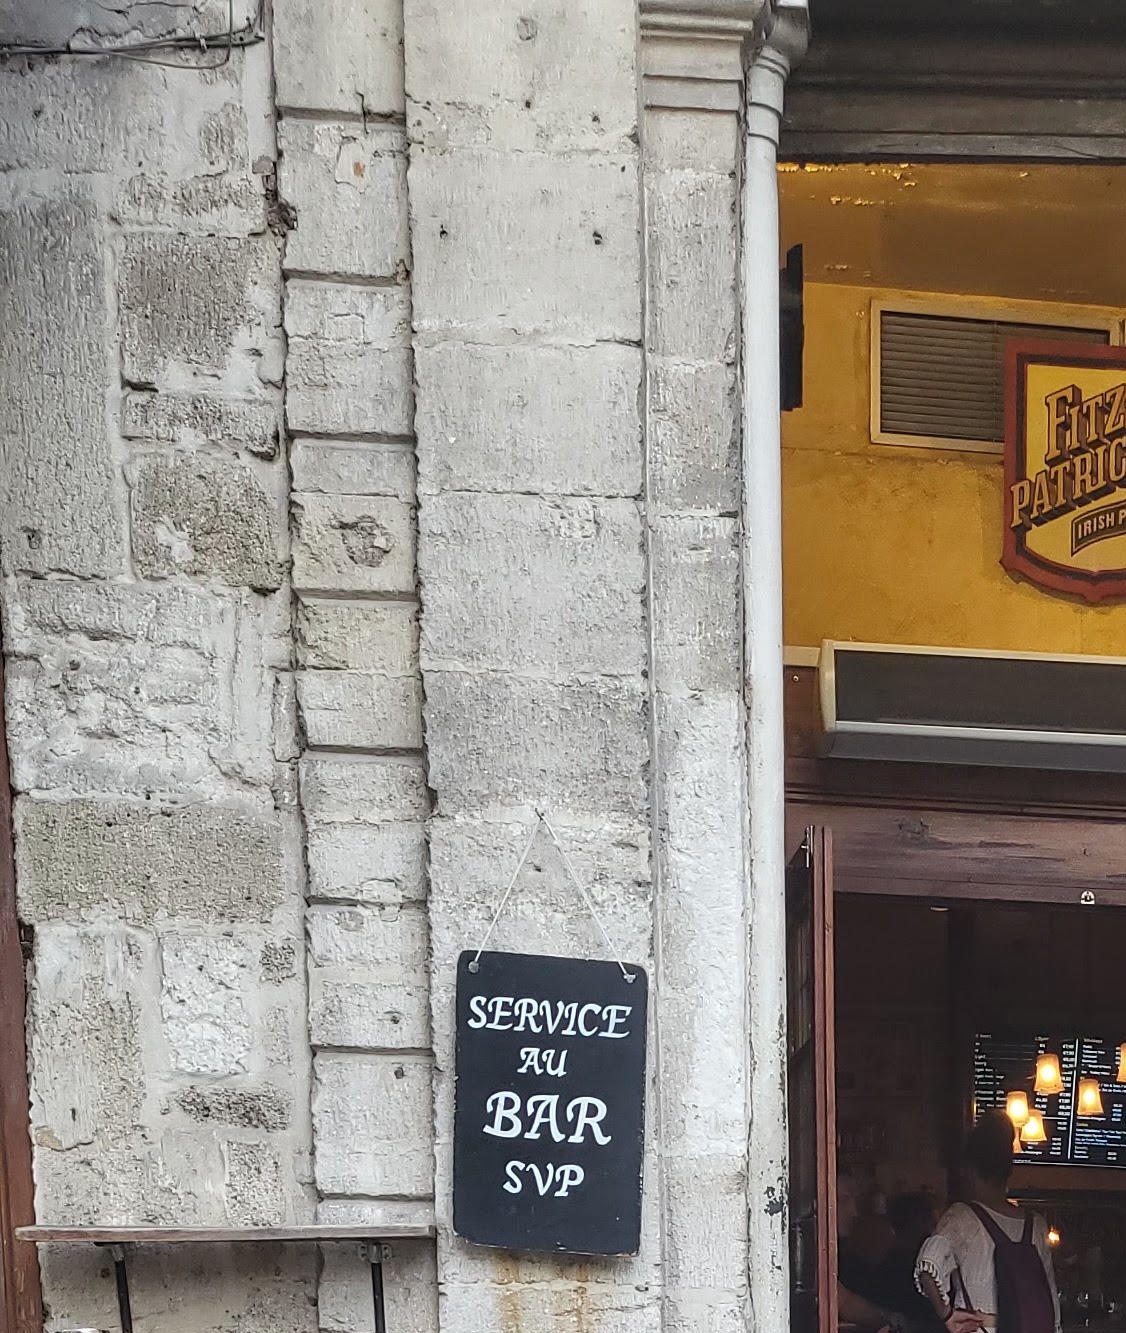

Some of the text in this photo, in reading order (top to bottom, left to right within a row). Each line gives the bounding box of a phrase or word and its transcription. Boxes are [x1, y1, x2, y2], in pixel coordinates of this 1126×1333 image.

[1077, 512, 1116, 540] IRISH
[467, 995, 633, 1039] SERVICE
[517, 1047, 568, 1078] AU
[482, 1090, 612, 1146] BAR
[502, 1160, 585, 1198] SVP
